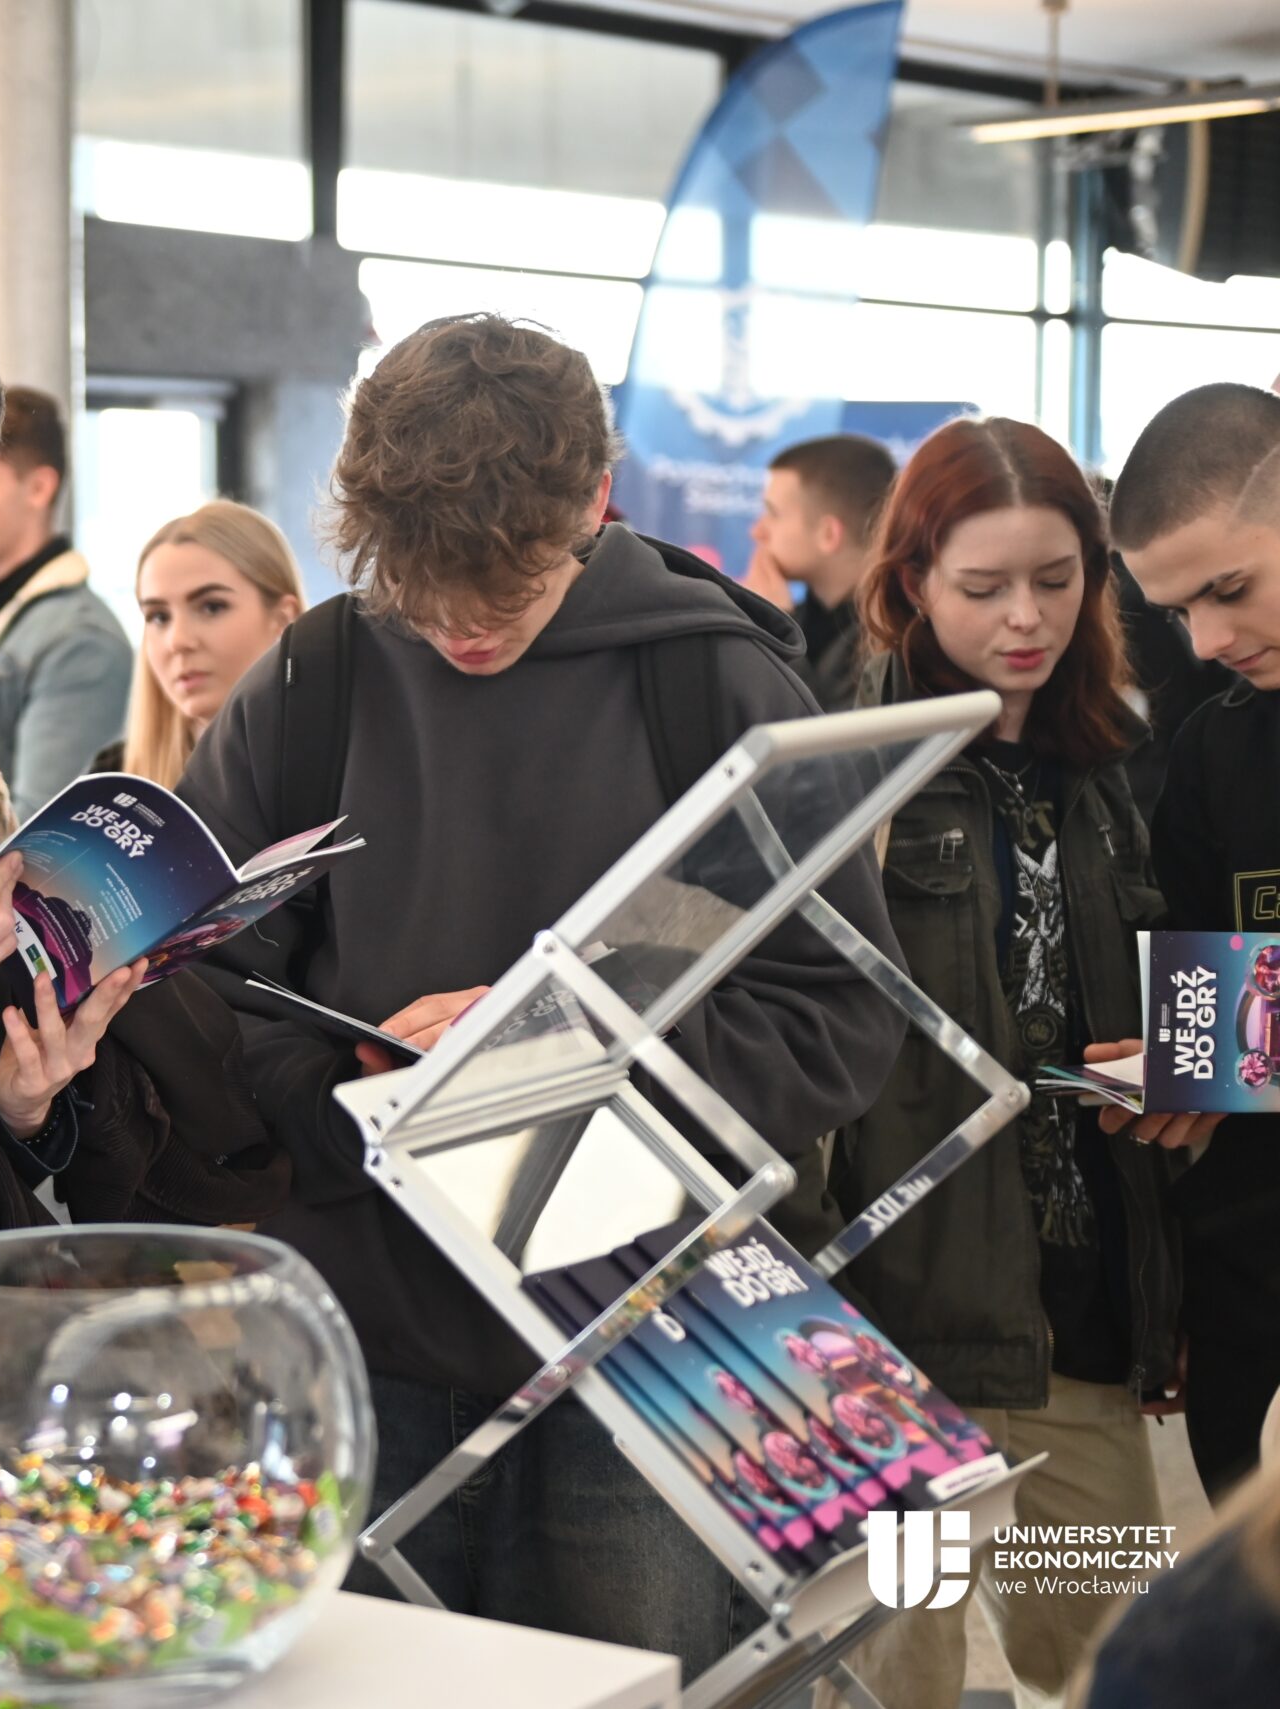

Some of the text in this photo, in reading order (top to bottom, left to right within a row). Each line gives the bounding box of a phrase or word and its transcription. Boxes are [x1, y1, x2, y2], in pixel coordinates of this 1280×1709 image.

[70, 811, 103, 827] DO
[104, 825, 145, 858] GRY
[86, 804, 154, 850] WEJDŹ
[1170, 970, 1197, 1076] WEJDŹ
[1193, 965, 1217, 1080] DO GRY
[722, 1274, 770, 1308] DO
